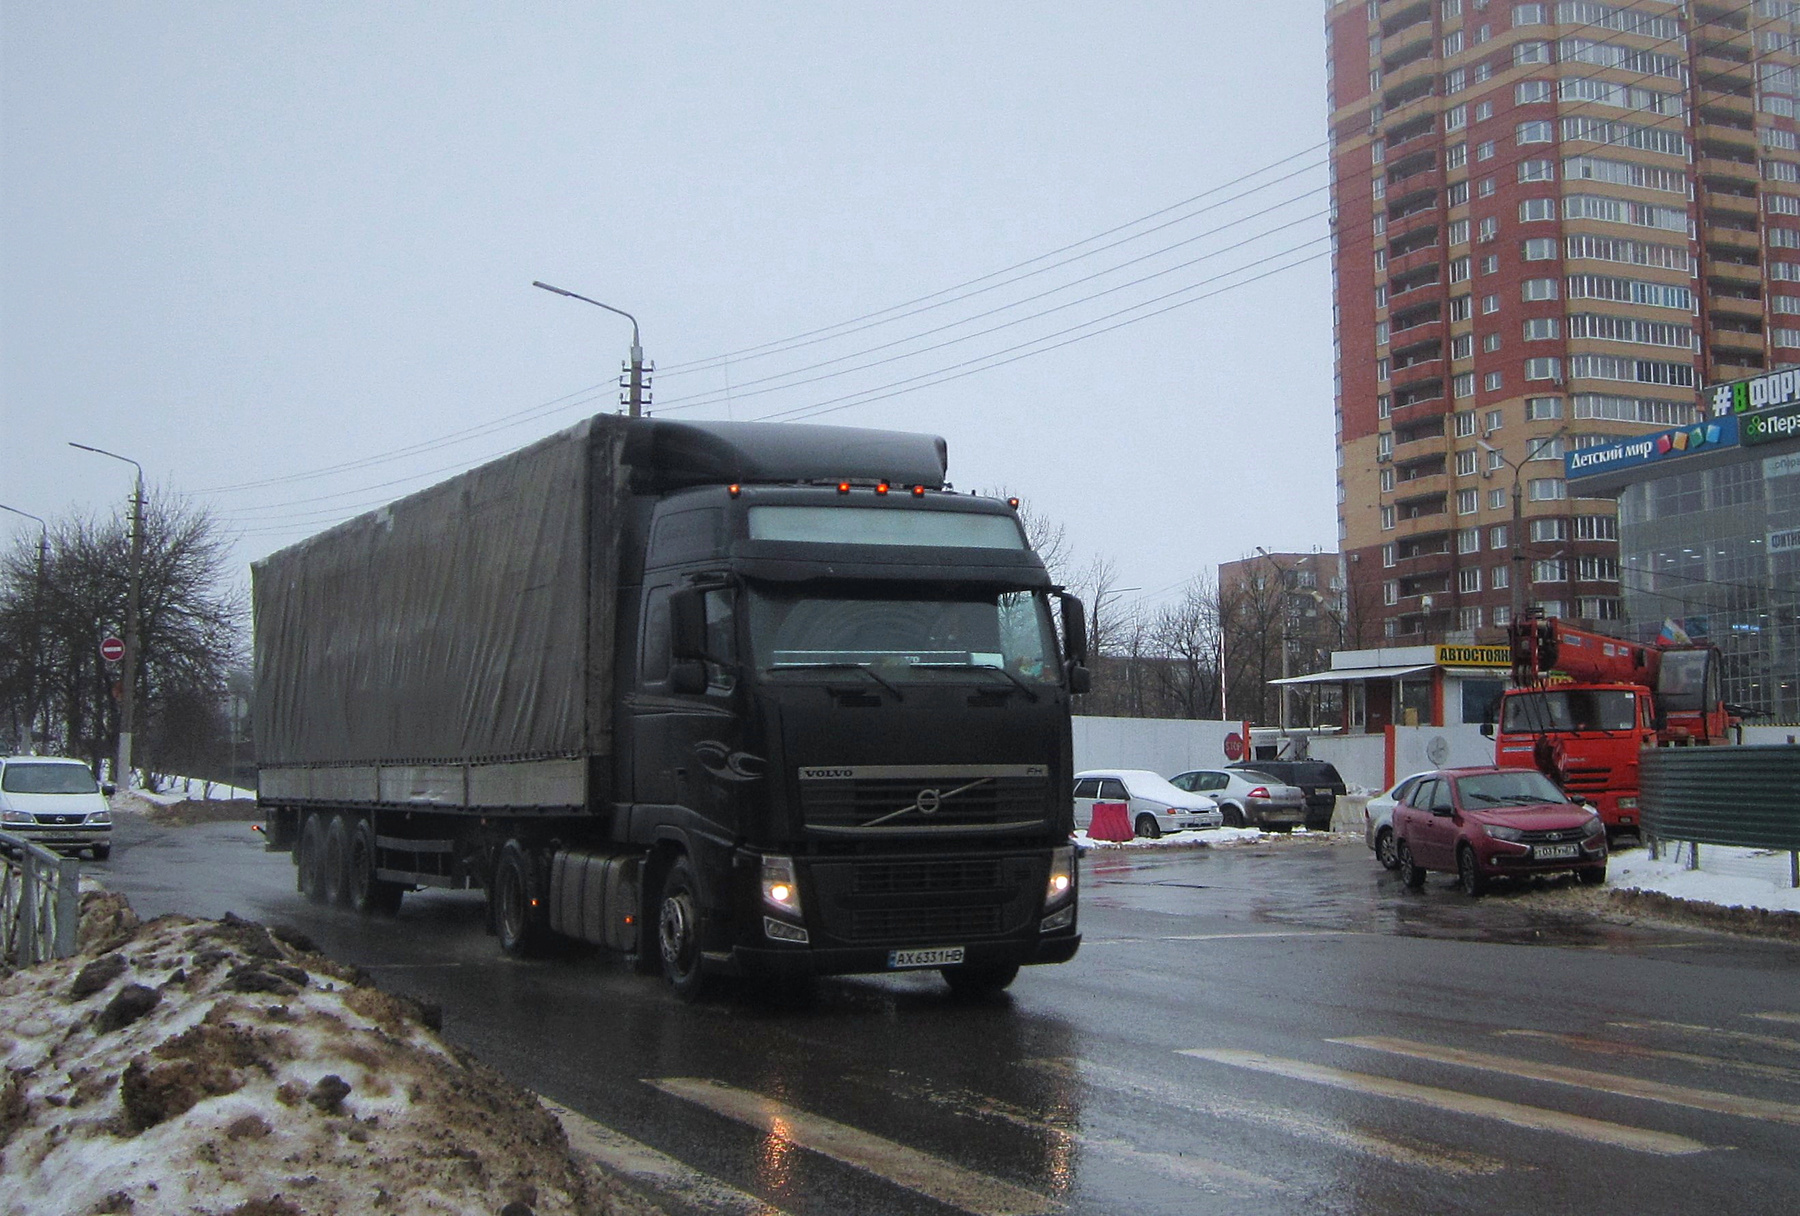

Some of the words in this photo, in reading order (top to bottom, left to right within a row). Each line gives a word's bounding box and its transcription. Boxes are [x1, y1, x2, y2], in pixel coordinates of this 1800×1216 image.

[1571, 444, 1623, 469] Детский
[1625, 441, 1653, 458] мир
[1440, 647, 1511, 662] АВТОСТОЯН
[1225, 741, 1243, 751] STOP
[805, 769, 853, 777] VOLVO
